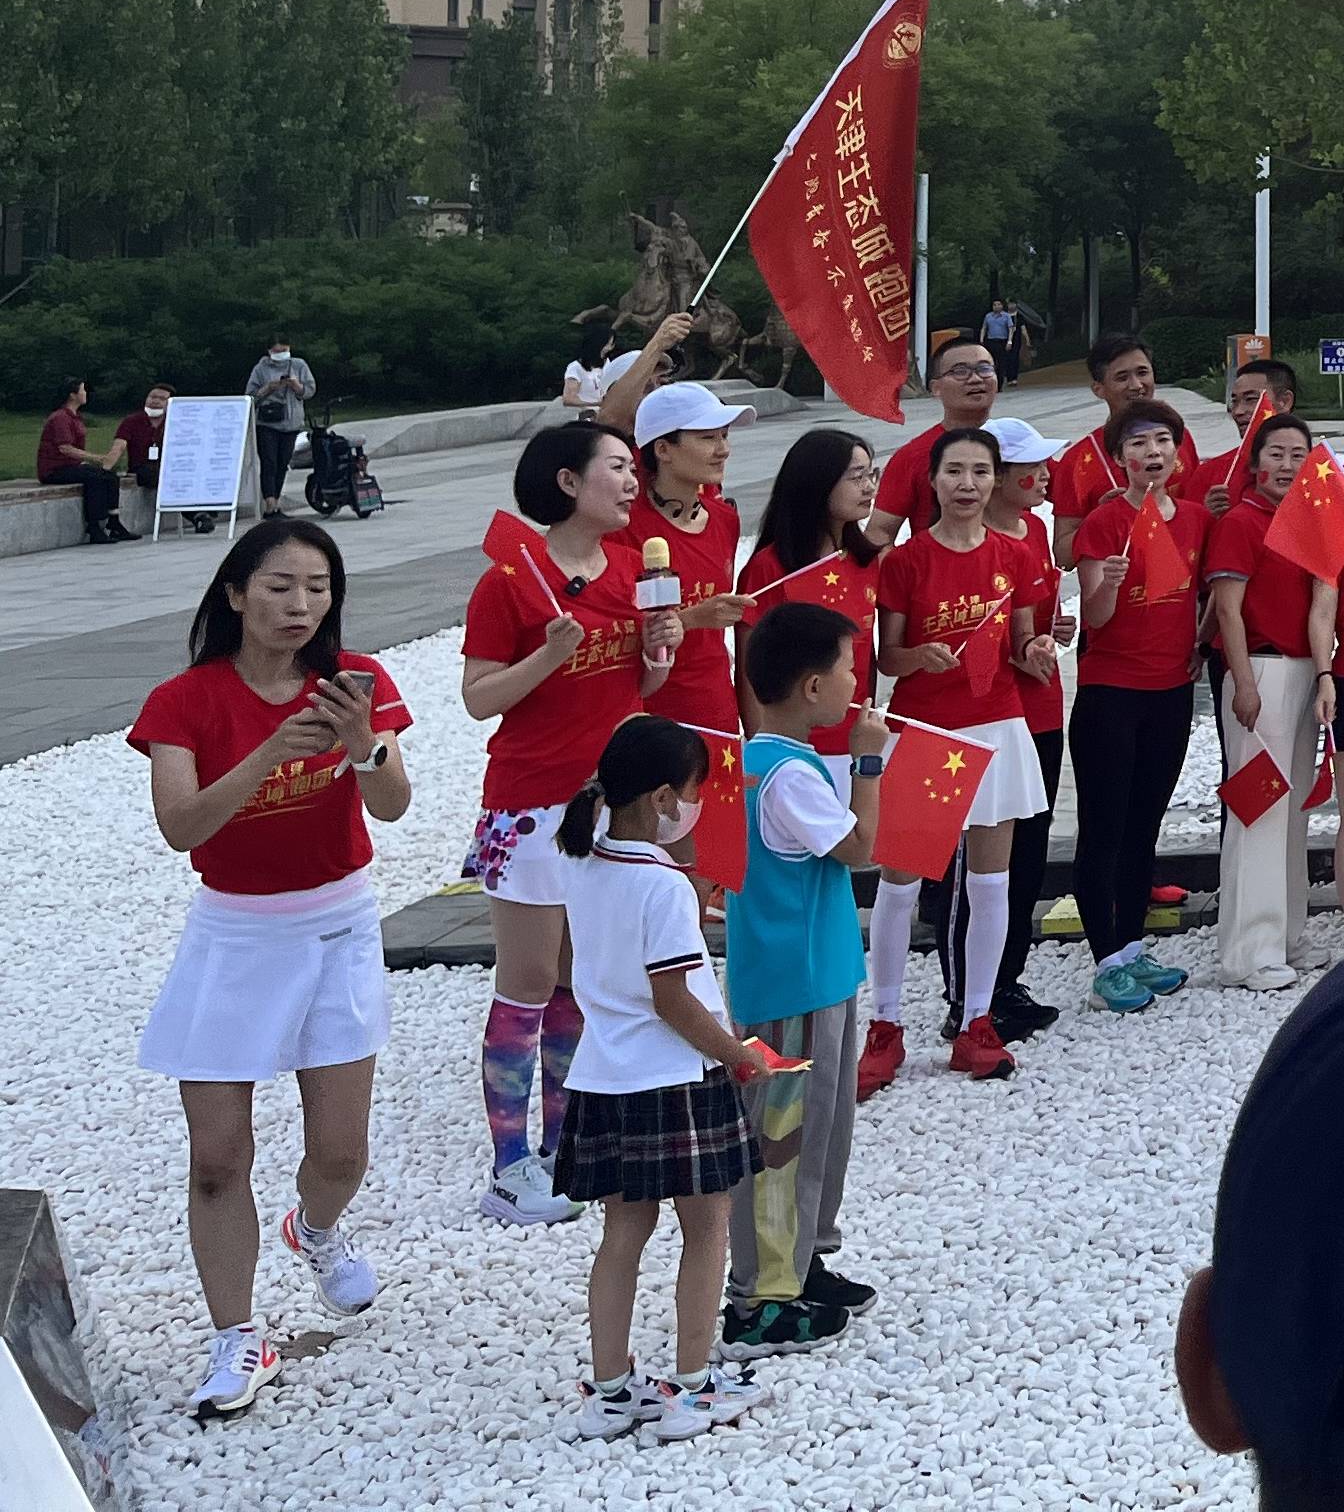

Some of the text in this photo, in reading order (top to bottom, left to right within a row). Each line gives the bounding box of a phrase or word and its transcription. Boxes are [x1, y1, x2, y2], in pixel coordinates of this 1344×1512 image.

[834, 84, 911, 342] 天津生态城跑团
